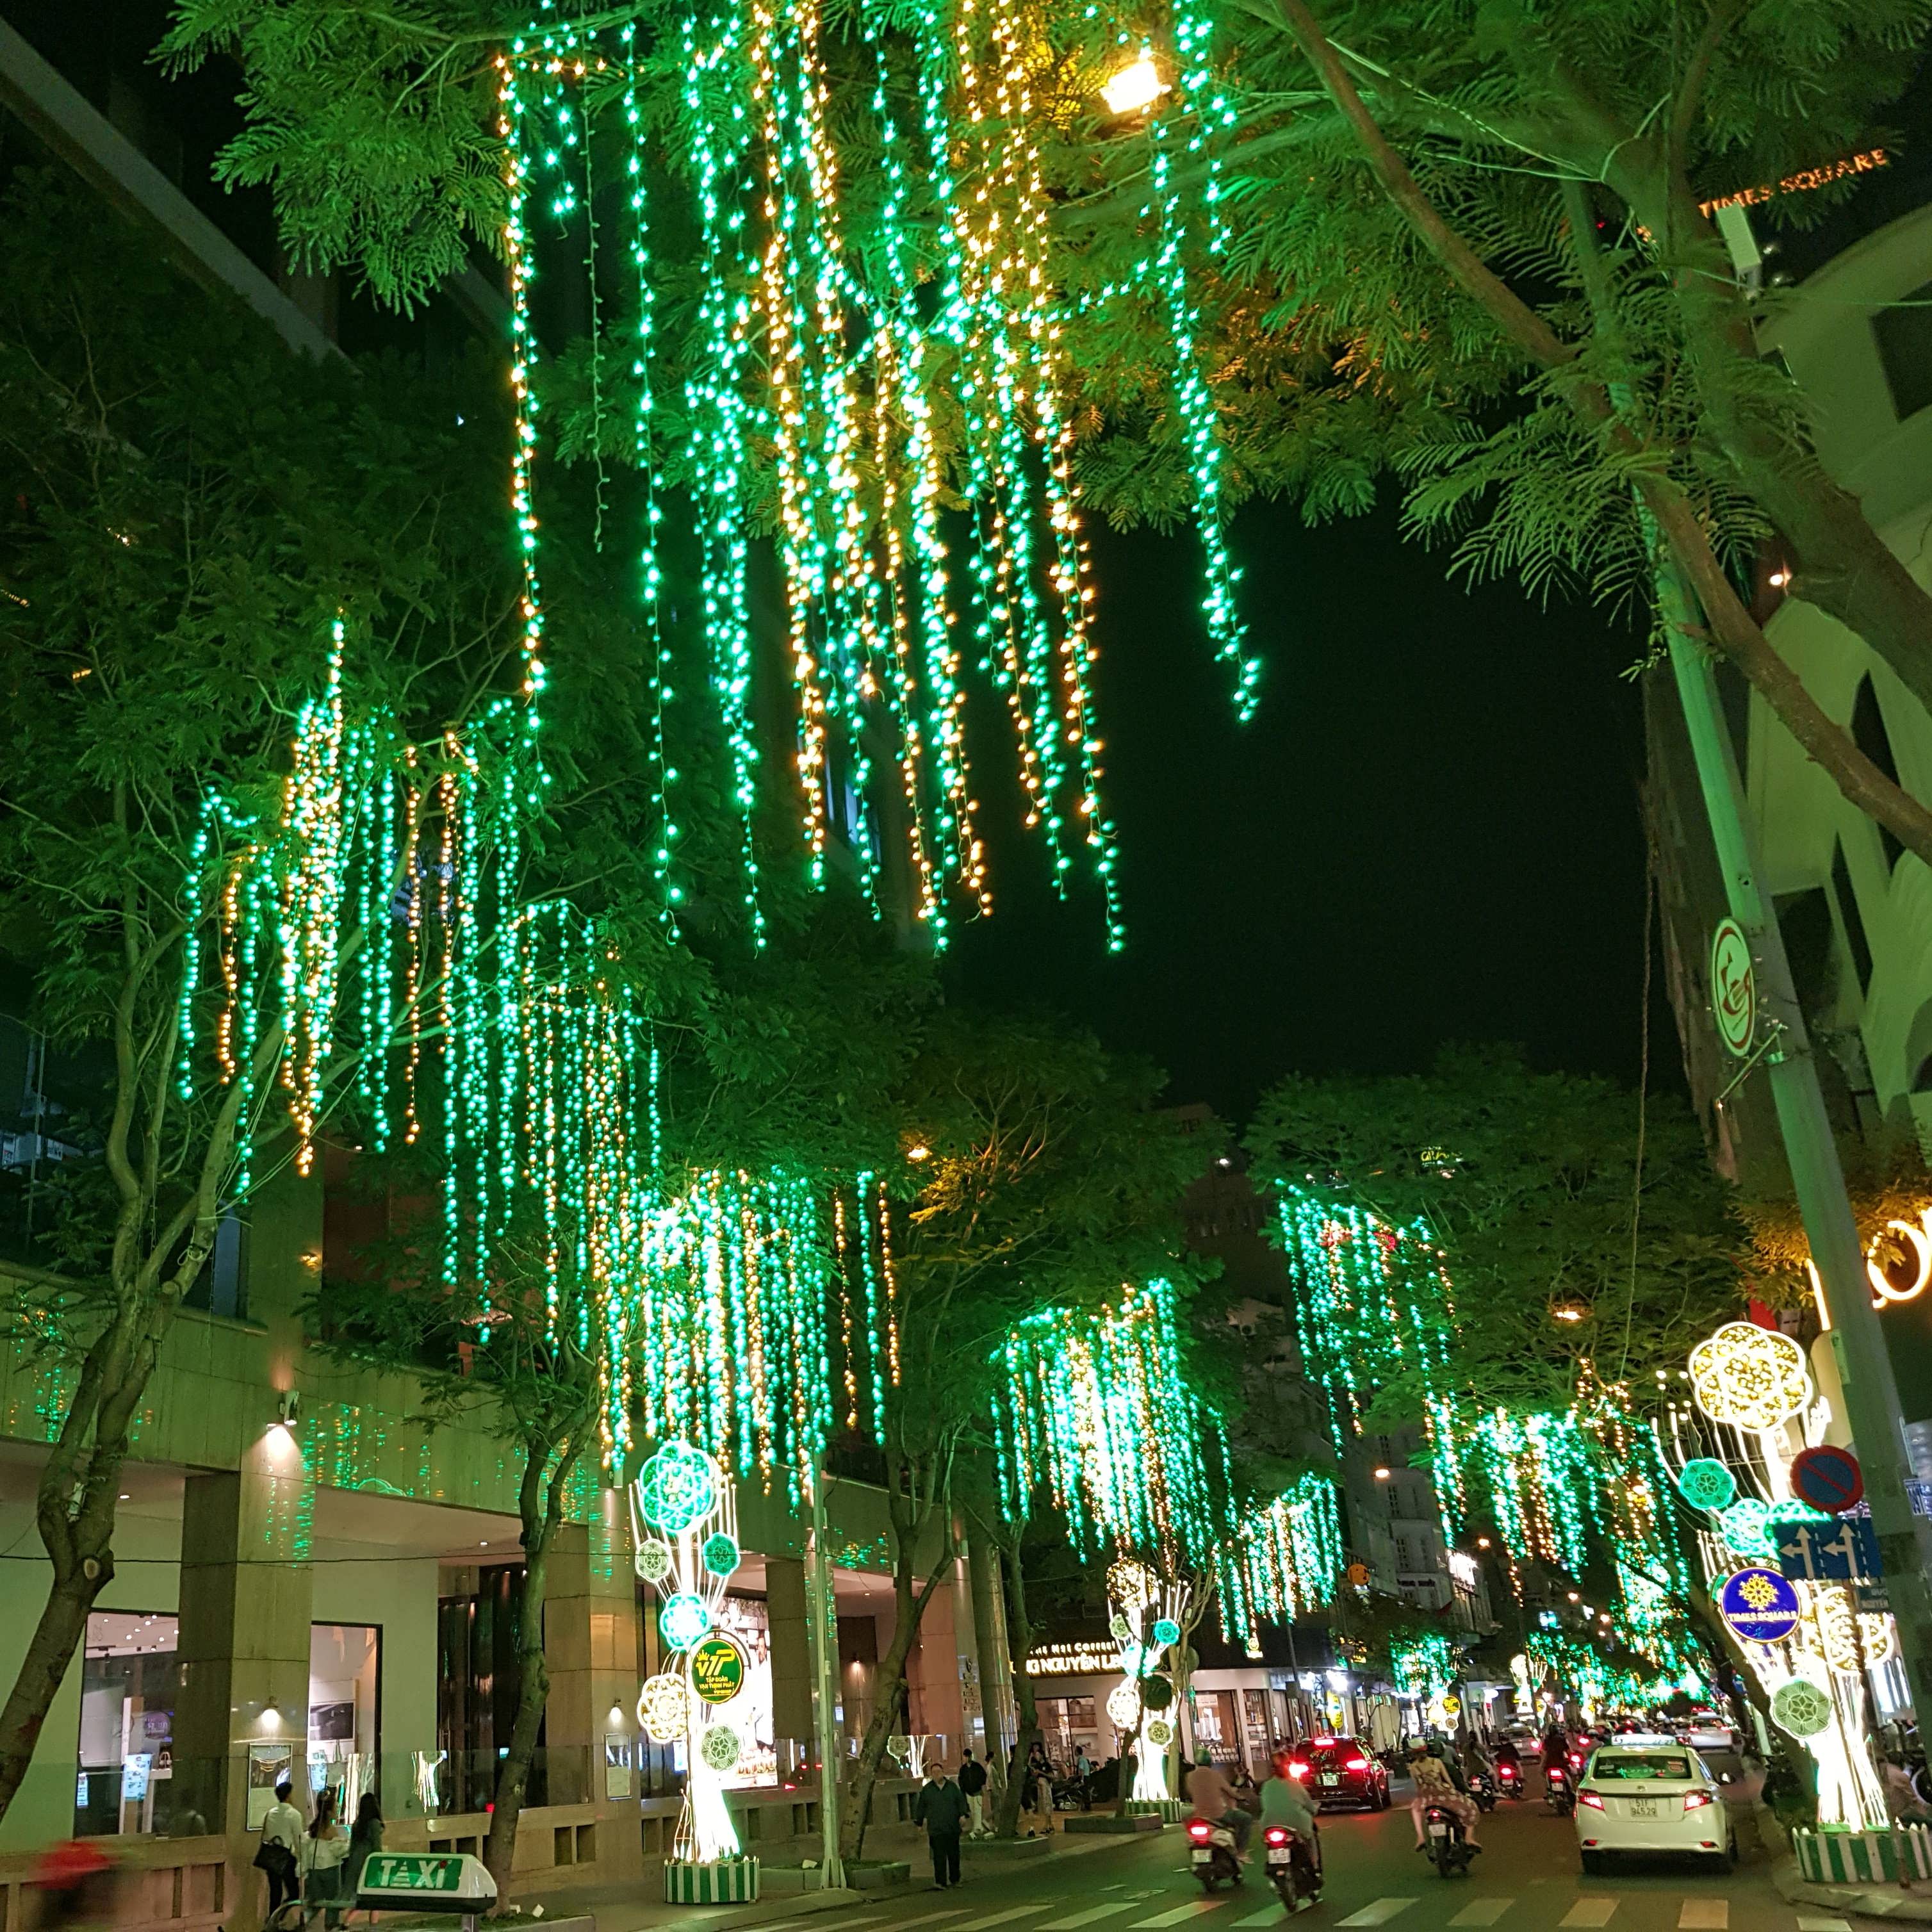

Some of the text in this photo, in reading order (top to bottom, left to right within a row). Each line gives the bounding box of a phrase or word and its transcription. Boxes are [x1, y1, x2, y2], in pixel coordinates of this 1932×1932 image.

[1699, 148, 1887, 219] TIMES SQUARE
[1728, 1612, 1756, 1621] TIMES
[1040, 1652, 1100, 1672] NGUYÊN
